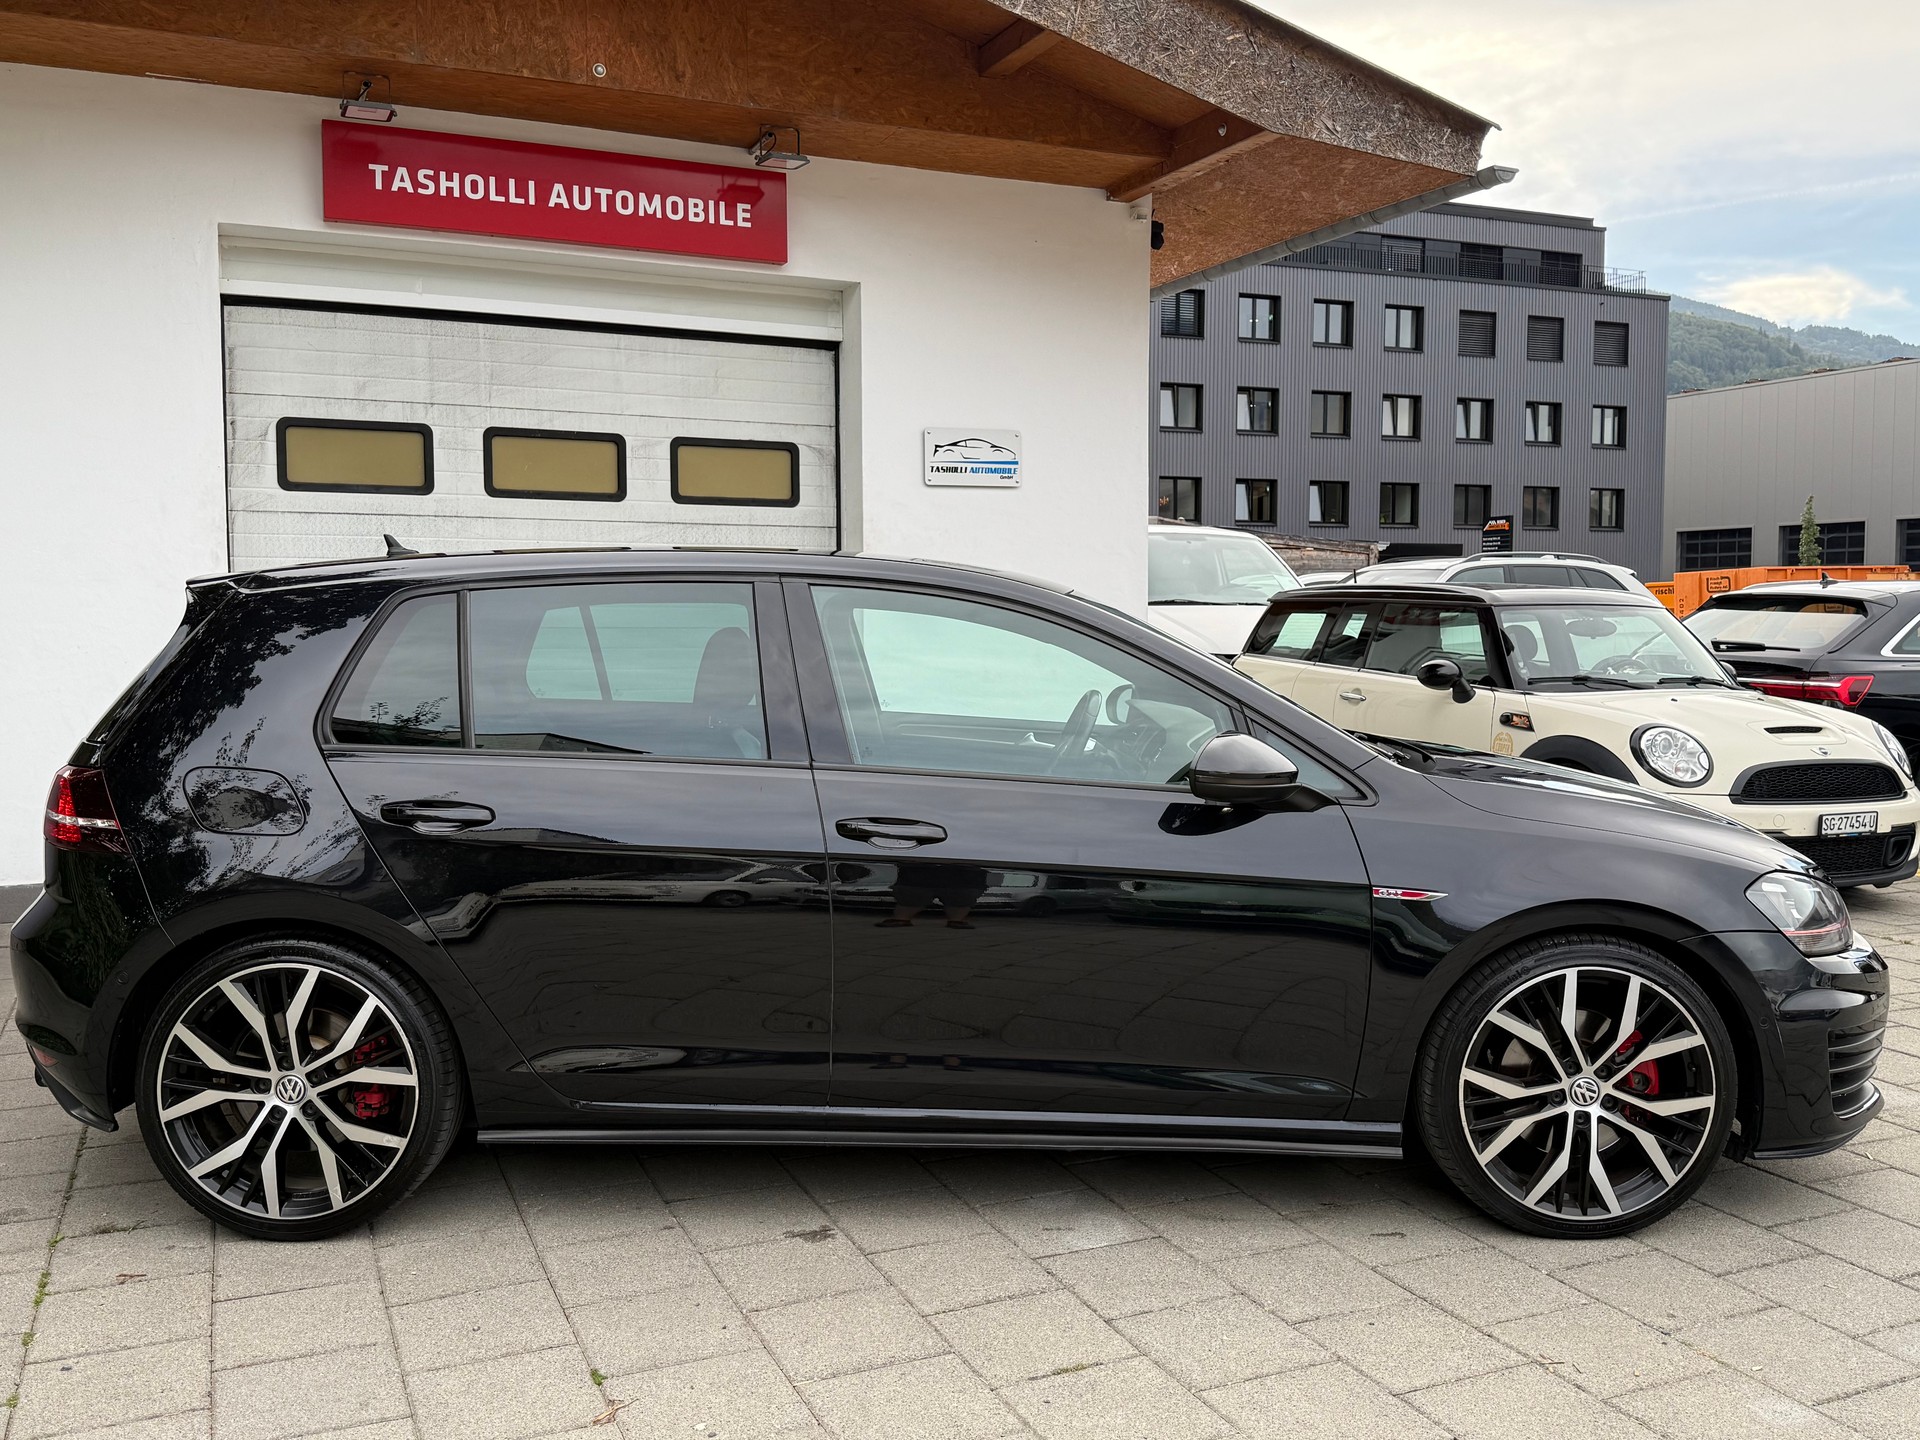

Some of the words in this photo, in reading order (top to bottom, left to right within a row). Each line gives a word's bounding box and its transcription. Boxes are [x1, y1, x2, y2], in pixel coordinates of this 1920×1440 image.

[368, 163, 536, 206] TASHOLLI
[547, 183, 753, 229] AUTOMOBILE
[930, 466, 968, 474] TASHOLLI
[969, 467, 1018, 475] AUTOMOBILE
